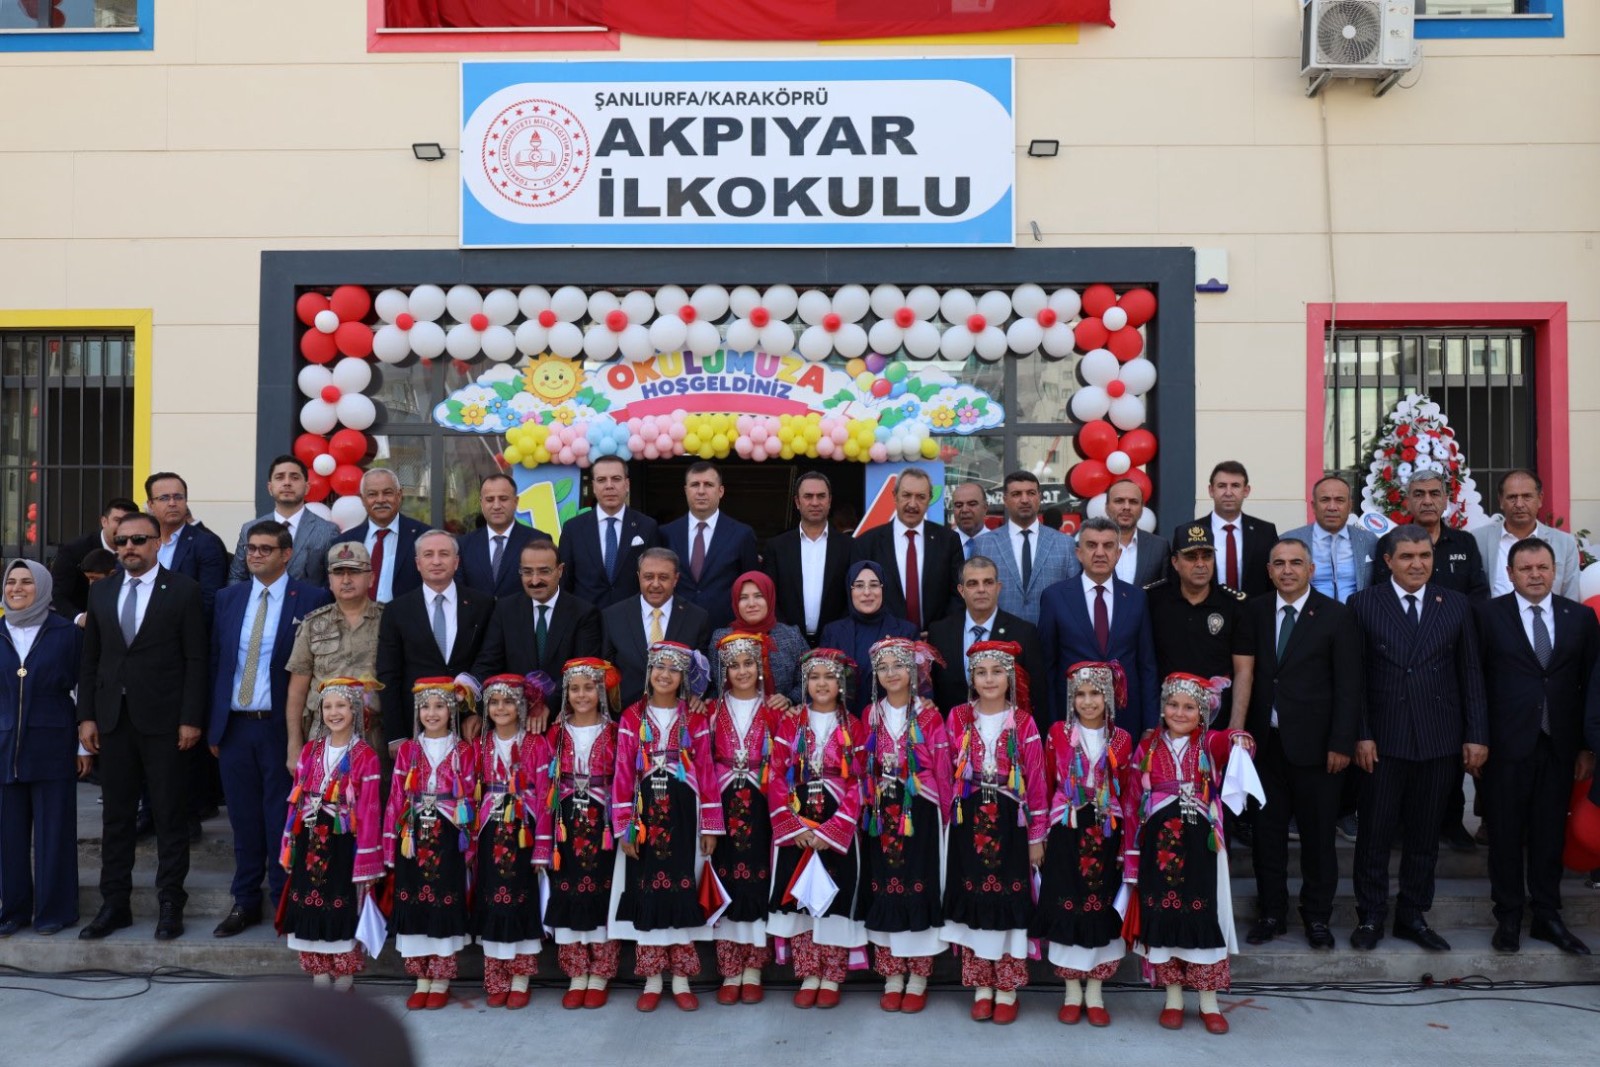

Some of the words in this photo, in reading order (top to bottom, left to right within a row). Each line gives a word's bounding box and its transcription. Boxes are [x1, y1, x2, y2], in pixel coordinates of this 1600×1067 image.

[595, 88, 828, 111] ŞANLIURFA/KARAKÖPRÜ
[595, 116, 917, 157] AKPIYAR
[599, 168, 971, 218] İLKOKULU
[607, 349, 825, 394] OKULUMUZA
[641, 374, 793, 400] HOŞGELDİNİZ
